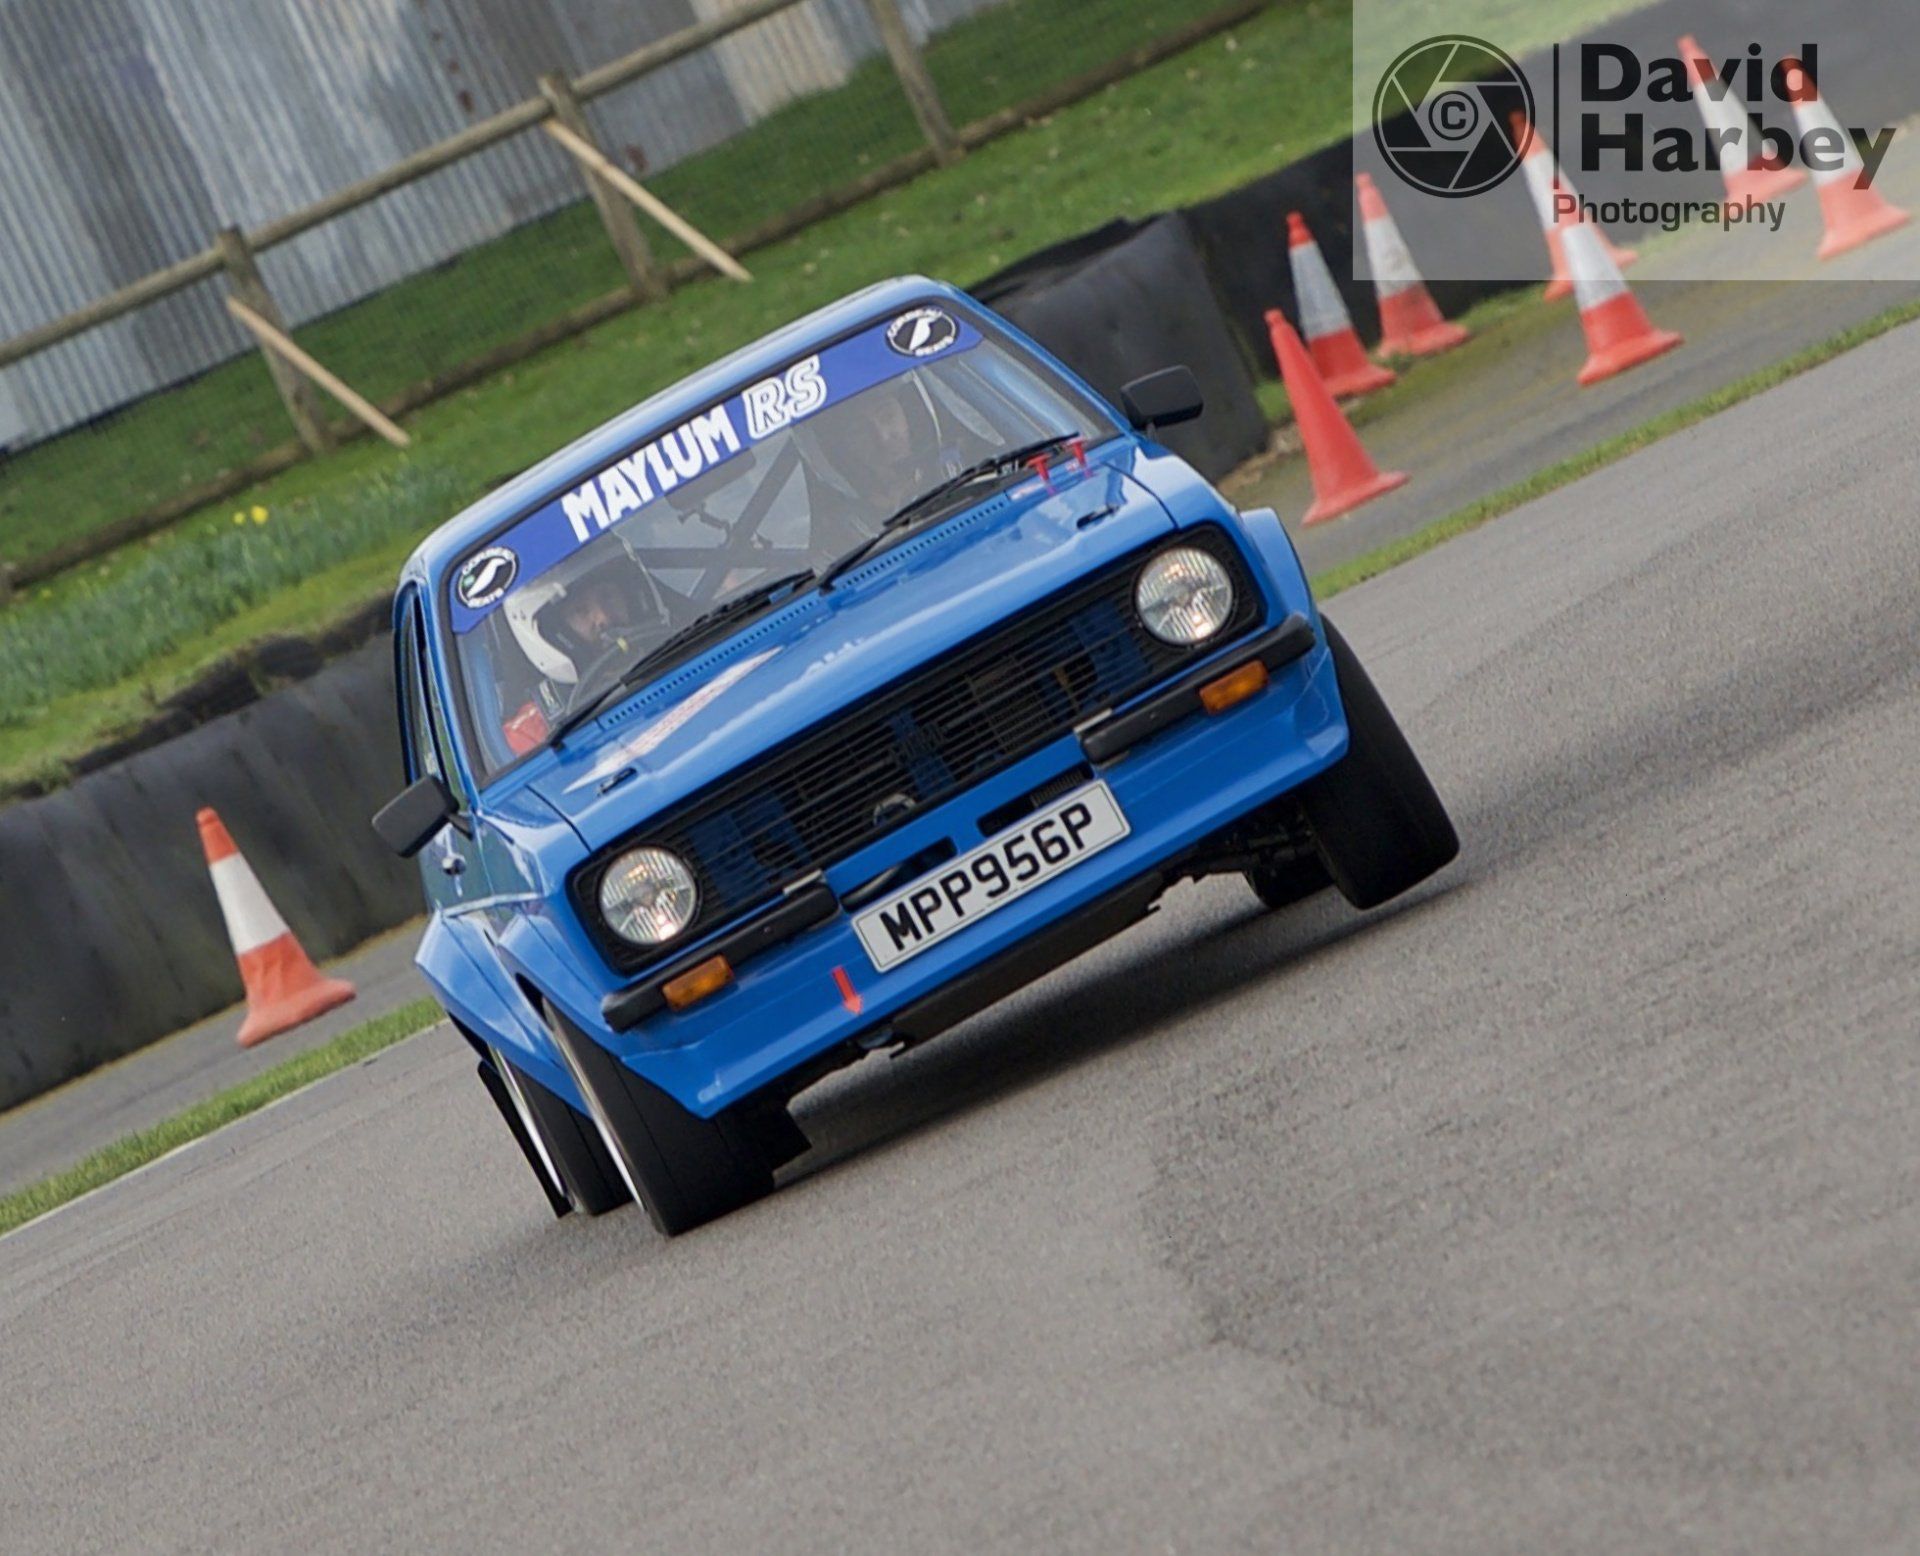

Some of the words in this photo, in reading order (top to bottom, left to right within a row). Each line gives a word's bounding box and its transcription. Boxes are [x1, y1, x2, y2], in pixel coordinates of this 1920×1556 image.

[561, 403, 741, 544] MAYLUM
[741, 354, 828, 440] RS
[879, 802, 1093, 952] MPP956P
